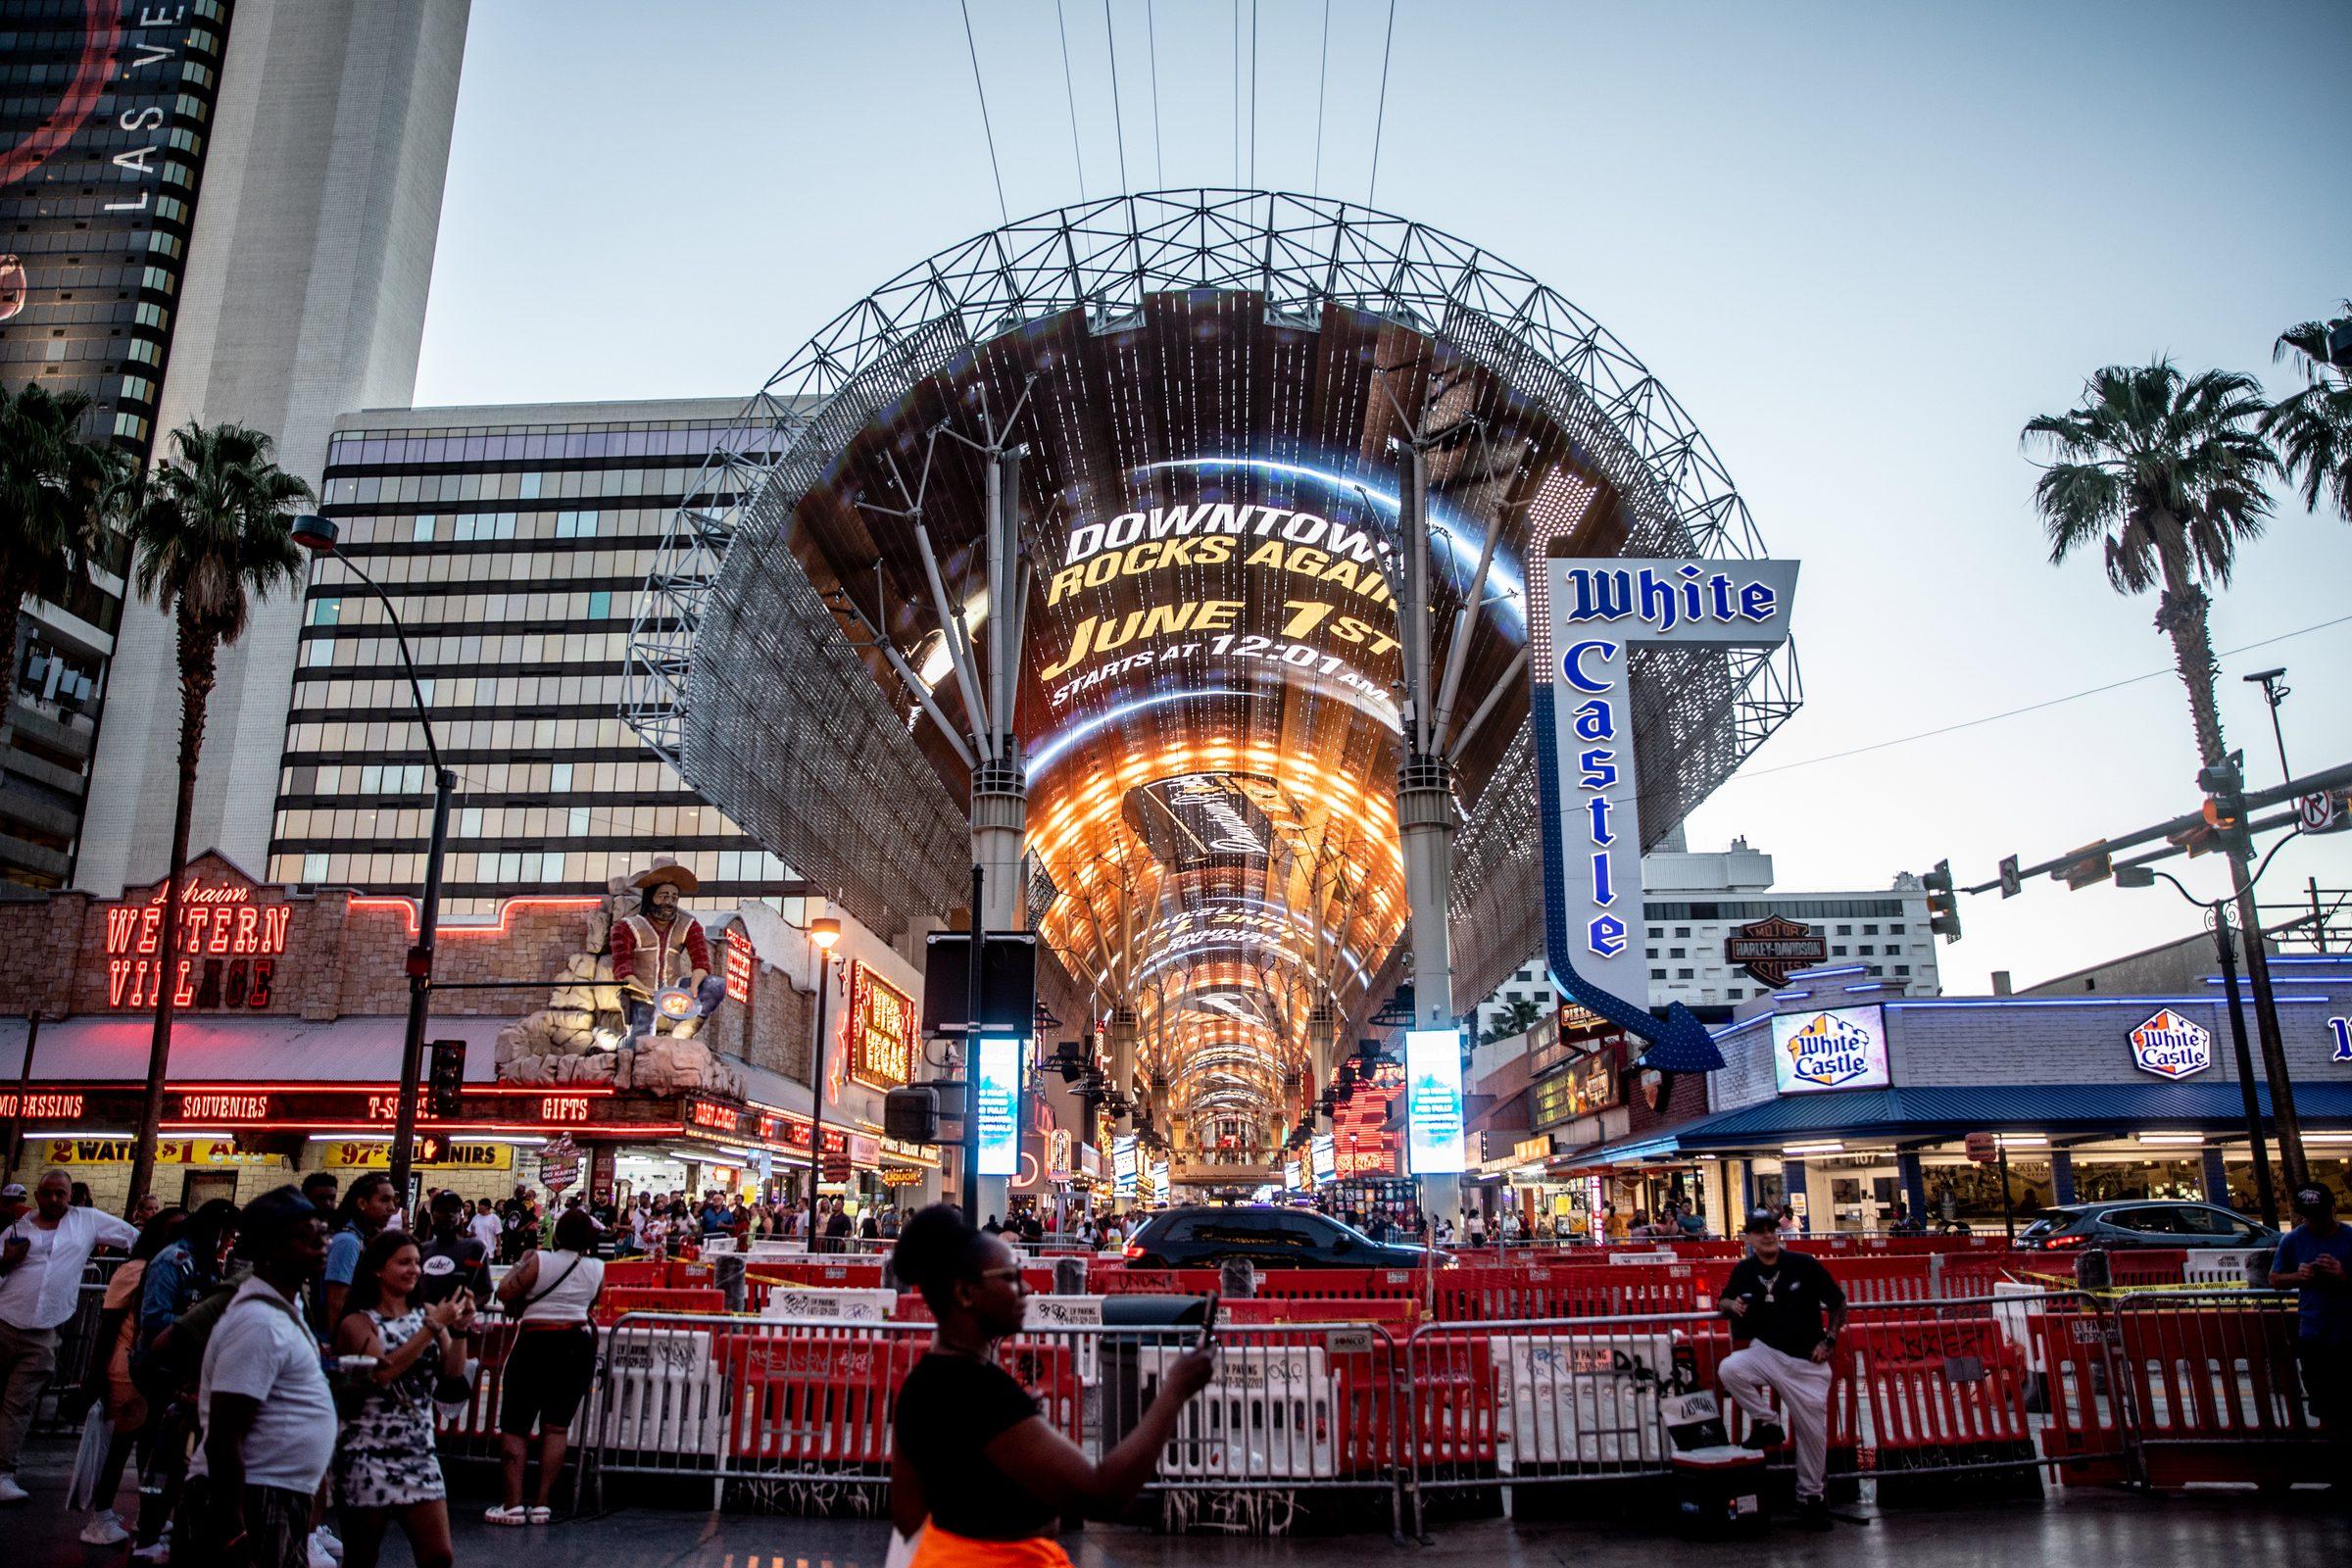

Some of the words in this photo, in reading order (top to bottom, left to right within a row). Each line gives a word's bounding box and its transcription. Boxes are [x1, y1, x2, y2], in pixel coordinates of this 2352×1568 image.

[105, 107, 164, 212] LAS
[1047, 536, 1237, 607] ROCKS
[1566, 564, 1777, 633] White
[1042, 601, 1246, 681] JUNE
[1281, 600, 1401, 656] 1ST
[1053, 650, 1156, 708] STARTS
[1159, 643, 1201, 662] AT
[1212, 634, 1345, 675] 12:01
[1340, 671, 1390, 702] AM
[1561, 639, 1628, 959] Castle
[107, 906, 290, 954] WETERN
[1755, 921, 1799, 938] MOTOR
[1736, 941, 1822, 957] HARLEY-DAVIDSON
[1798, 1035, 1860, 1057] White
[2143, 1030, 2199, 1050] White
[1795, 1054, 1865, 1076] Castle
[2141, 1049, 2204, 1065] Castle
[183, 1096, 267, 1118] SOUVENIRS
[543, 1098, 588, 1119] GIFTS
[52, 1140, 73, 1163] 2
[544, 1176, 576, 1185] INDOORS
[554, 1168, 577, 1177] KARTS
[1077, 1306, 1096, 1315] PAVING
[1335, 1337, 1365, 1346] SONCO
